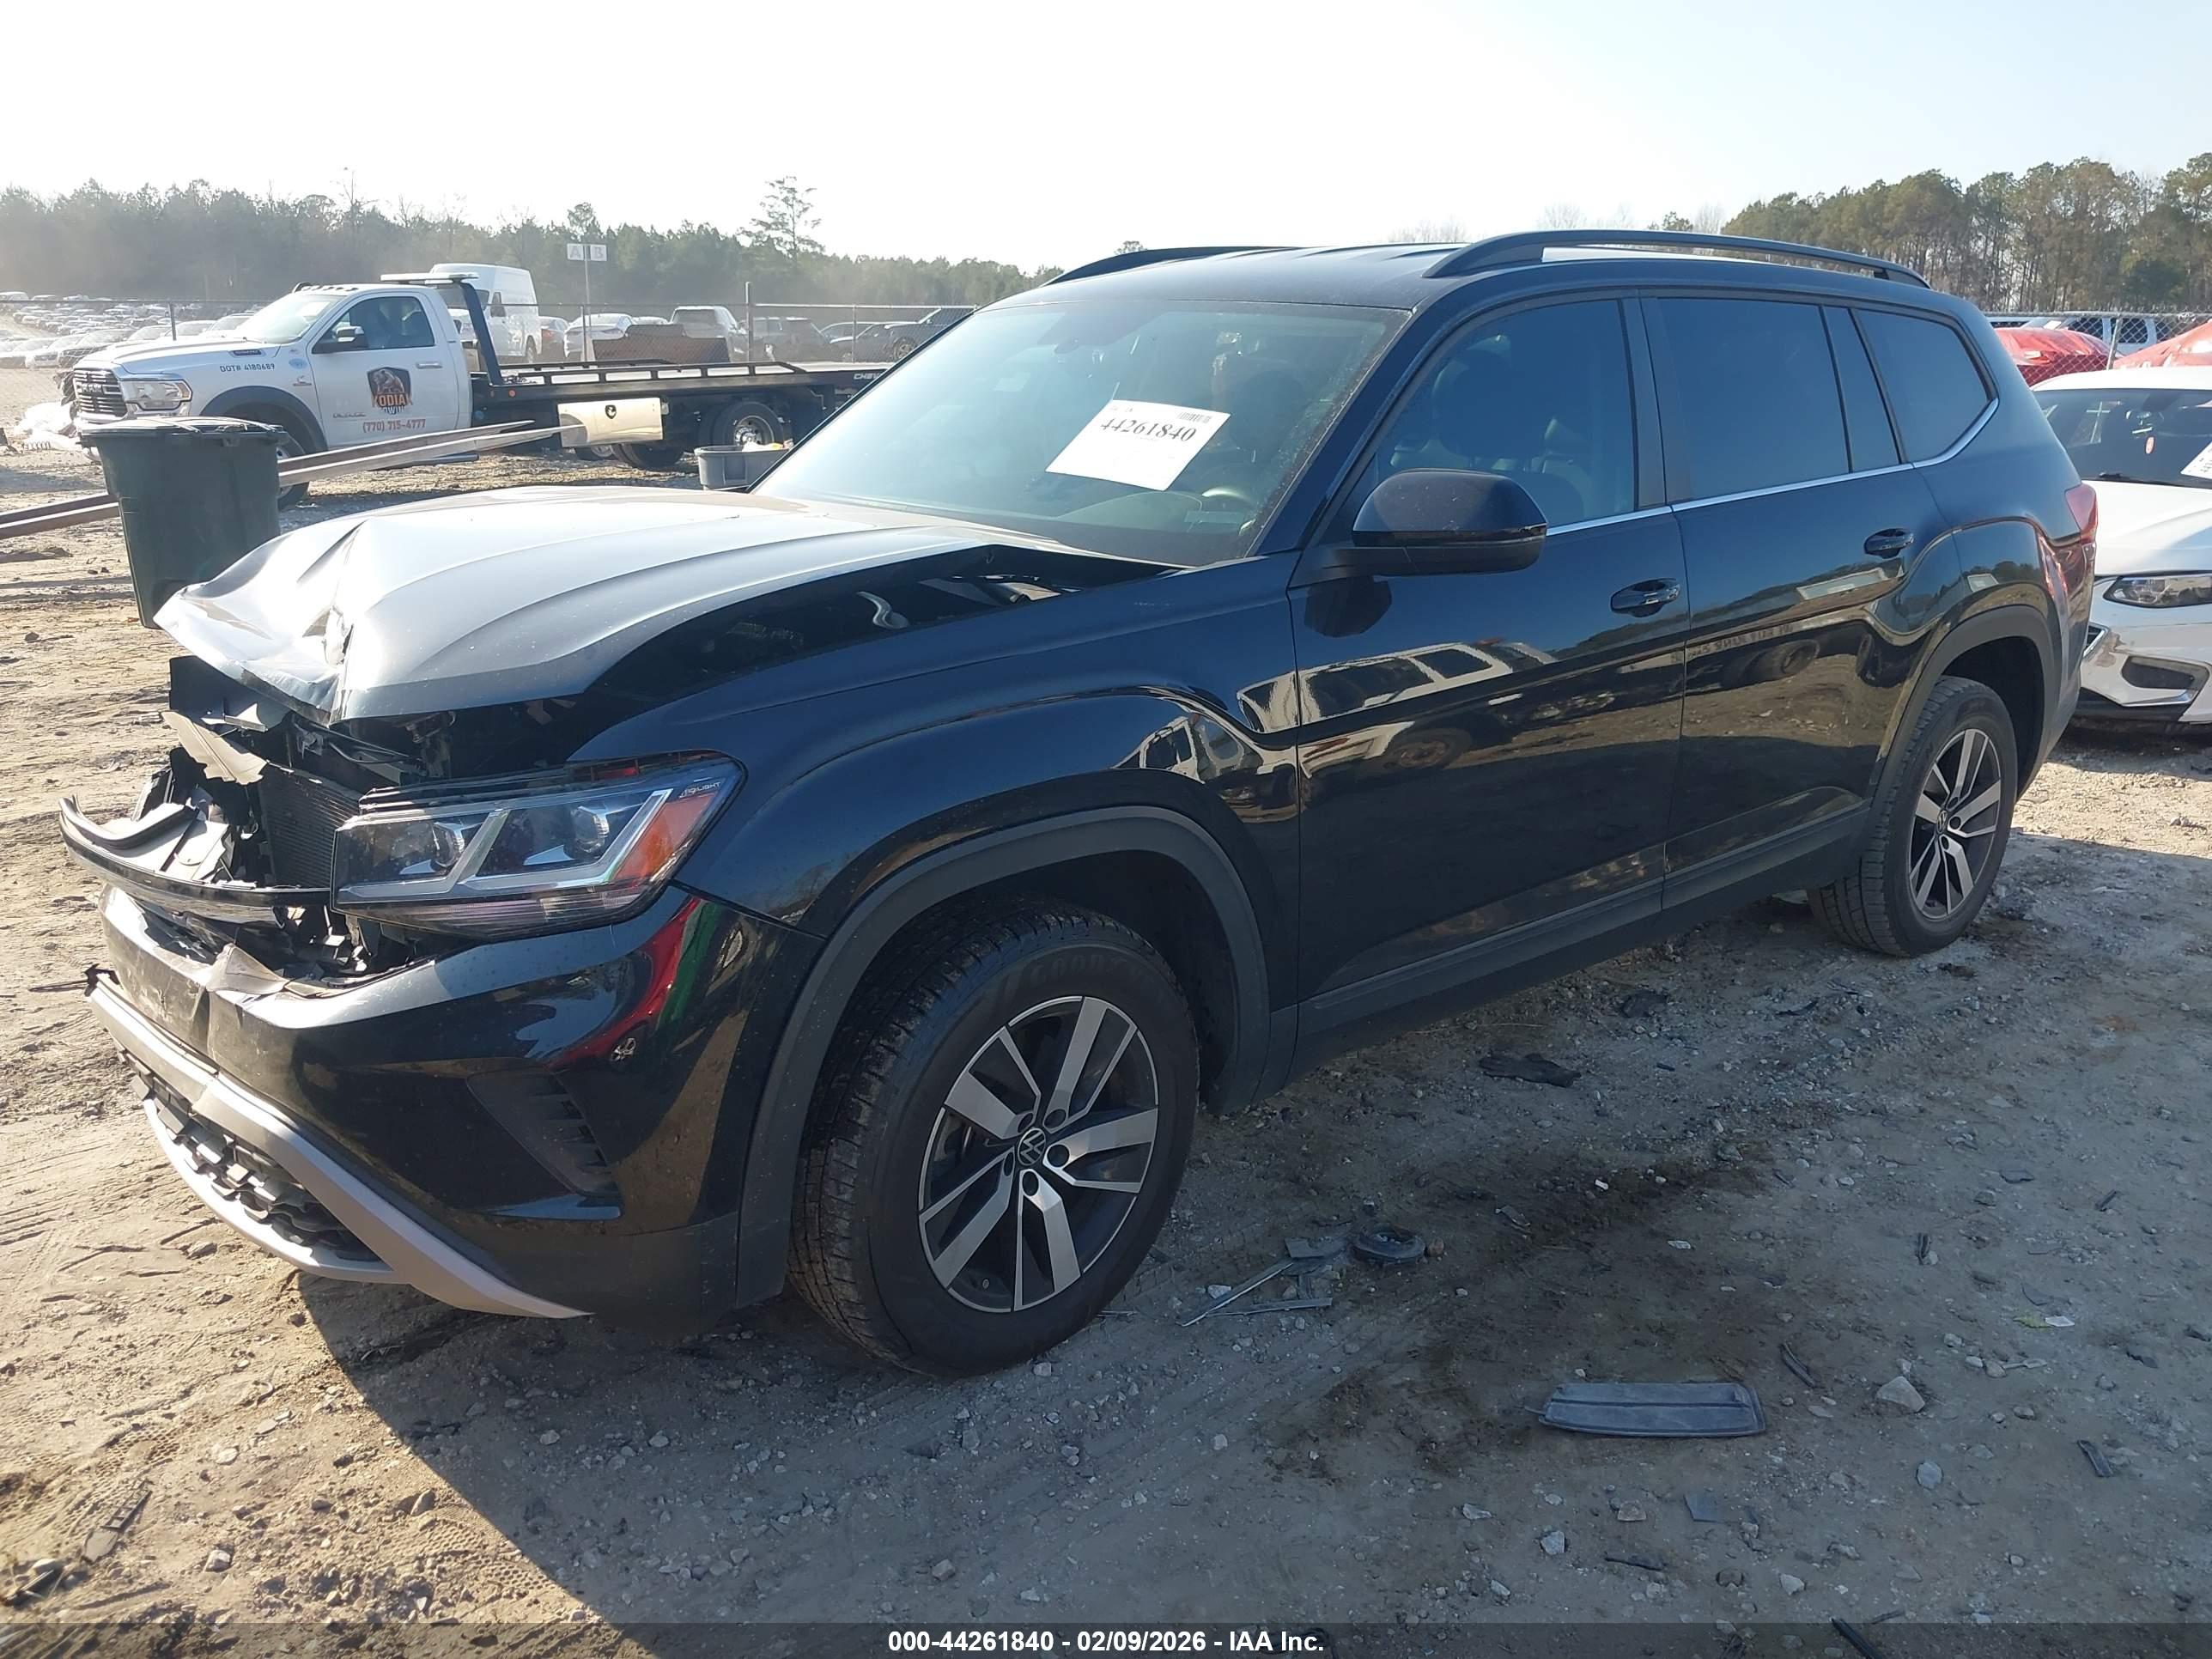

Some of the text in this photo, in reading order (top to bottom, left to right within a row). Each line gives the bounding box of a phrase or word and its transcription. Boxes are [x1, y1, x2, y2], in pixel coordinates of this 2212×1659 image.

[569, 246, 582, 258] A
[593, 246, 605, 258] B
[219, 364, 241, 373] DOT#
[362, 419, 426, 433] (770) 715-4777
[1100, 417, 1197, 442] 44261840
